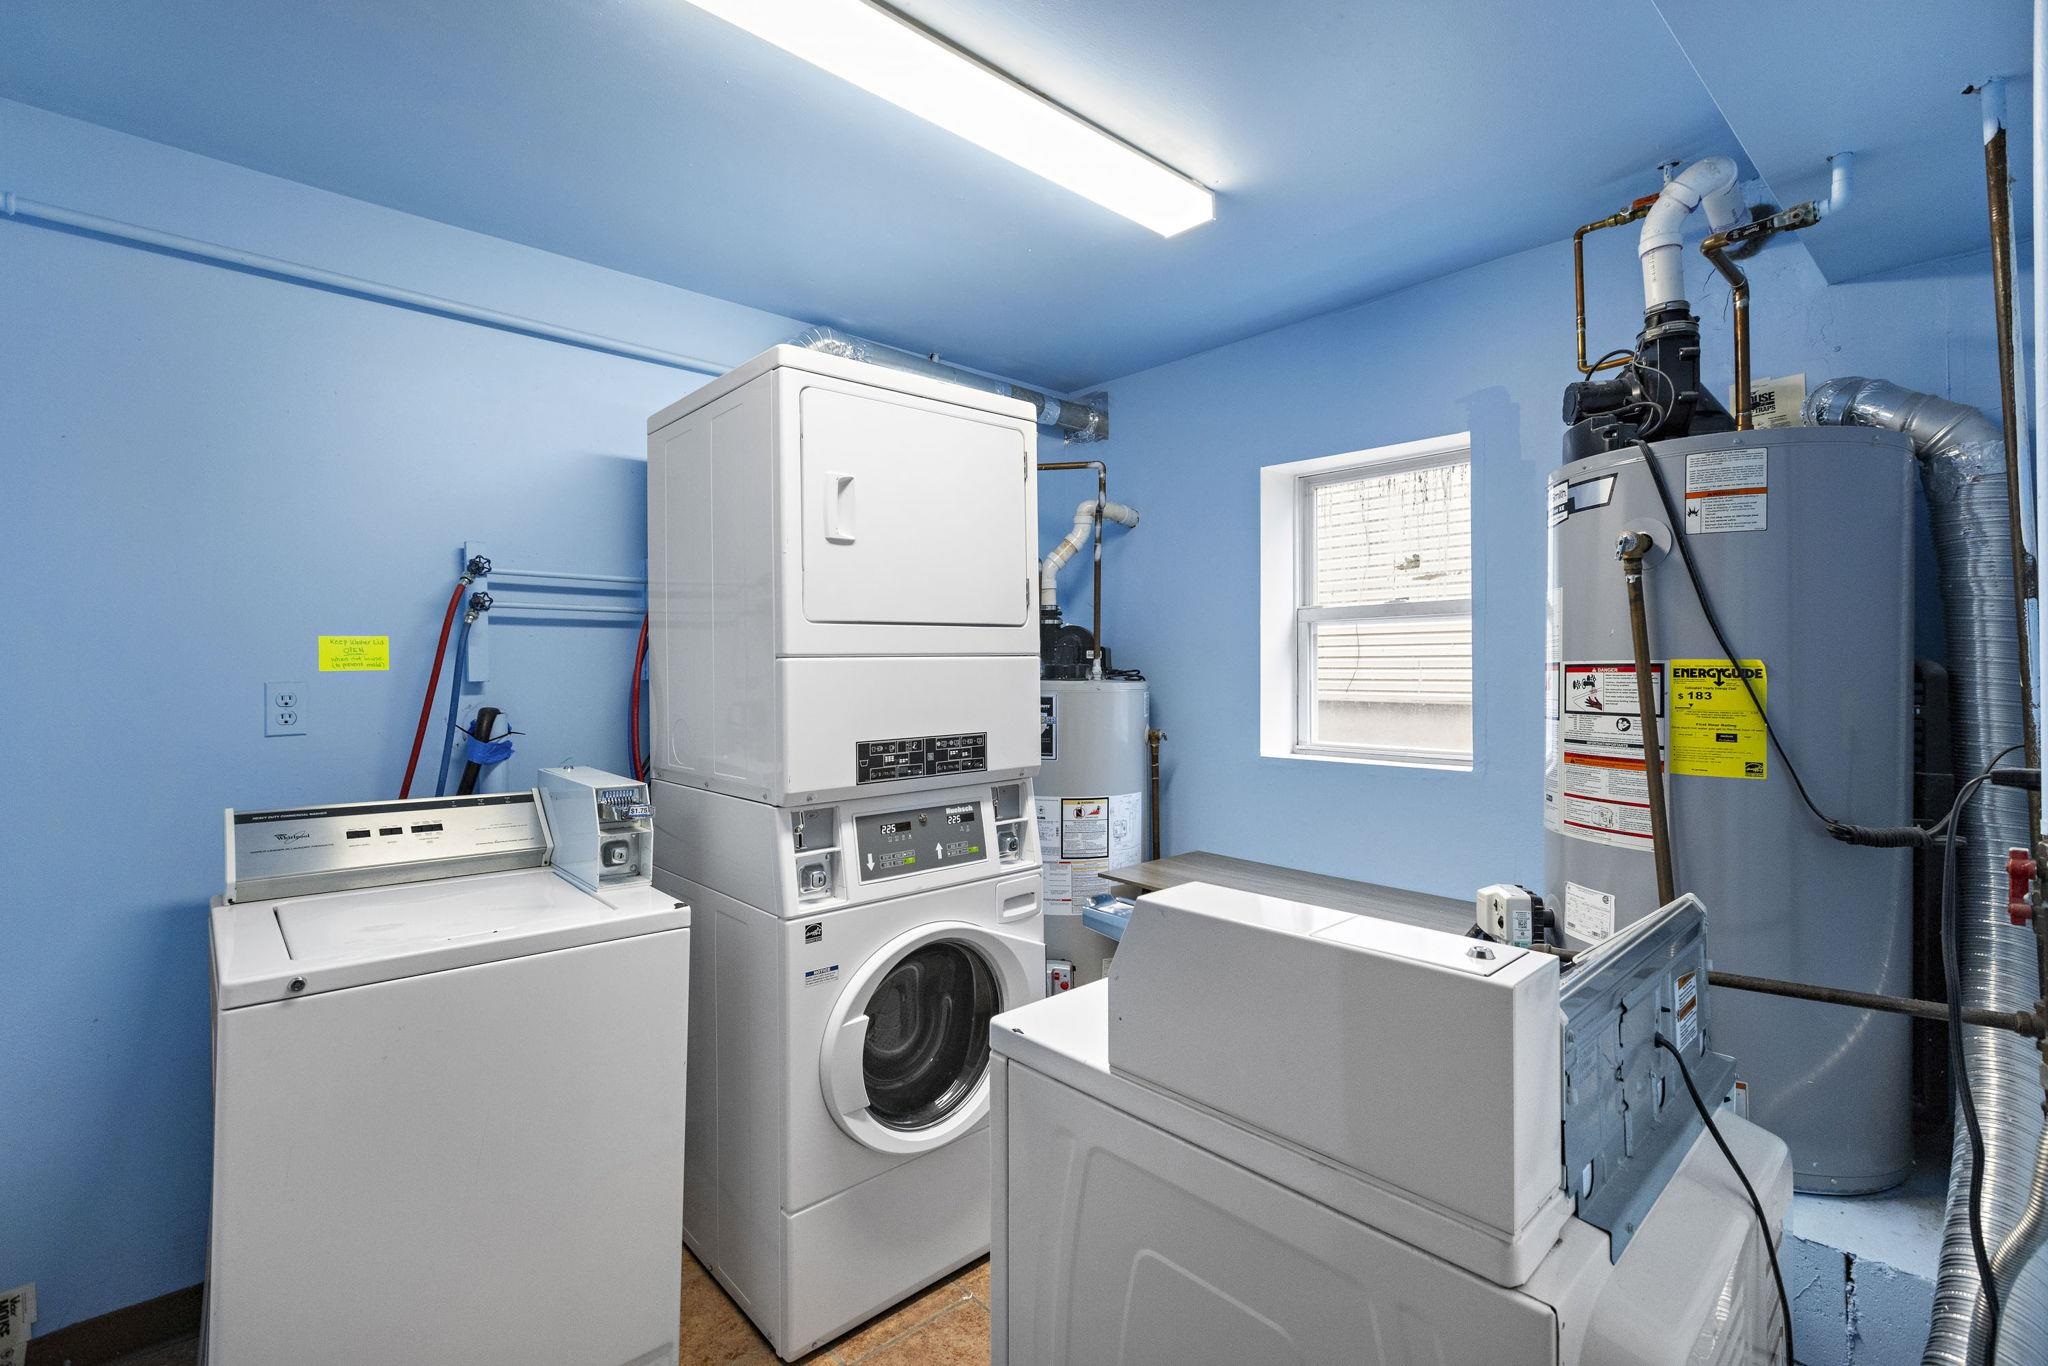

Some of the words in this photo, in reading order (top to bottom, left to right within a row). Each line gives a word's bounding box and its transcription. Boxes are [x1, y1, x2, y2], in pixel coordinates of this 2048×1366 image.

[1678, 692, 1684, 700] $
[1687, 691, 1713, 700] 183
[630, 807, 648, 815] $1.75
[948, 815, 961, 824] 225
[881, 824, 896, 834] 225
[274, 832, 310, 842] Whirlpool
